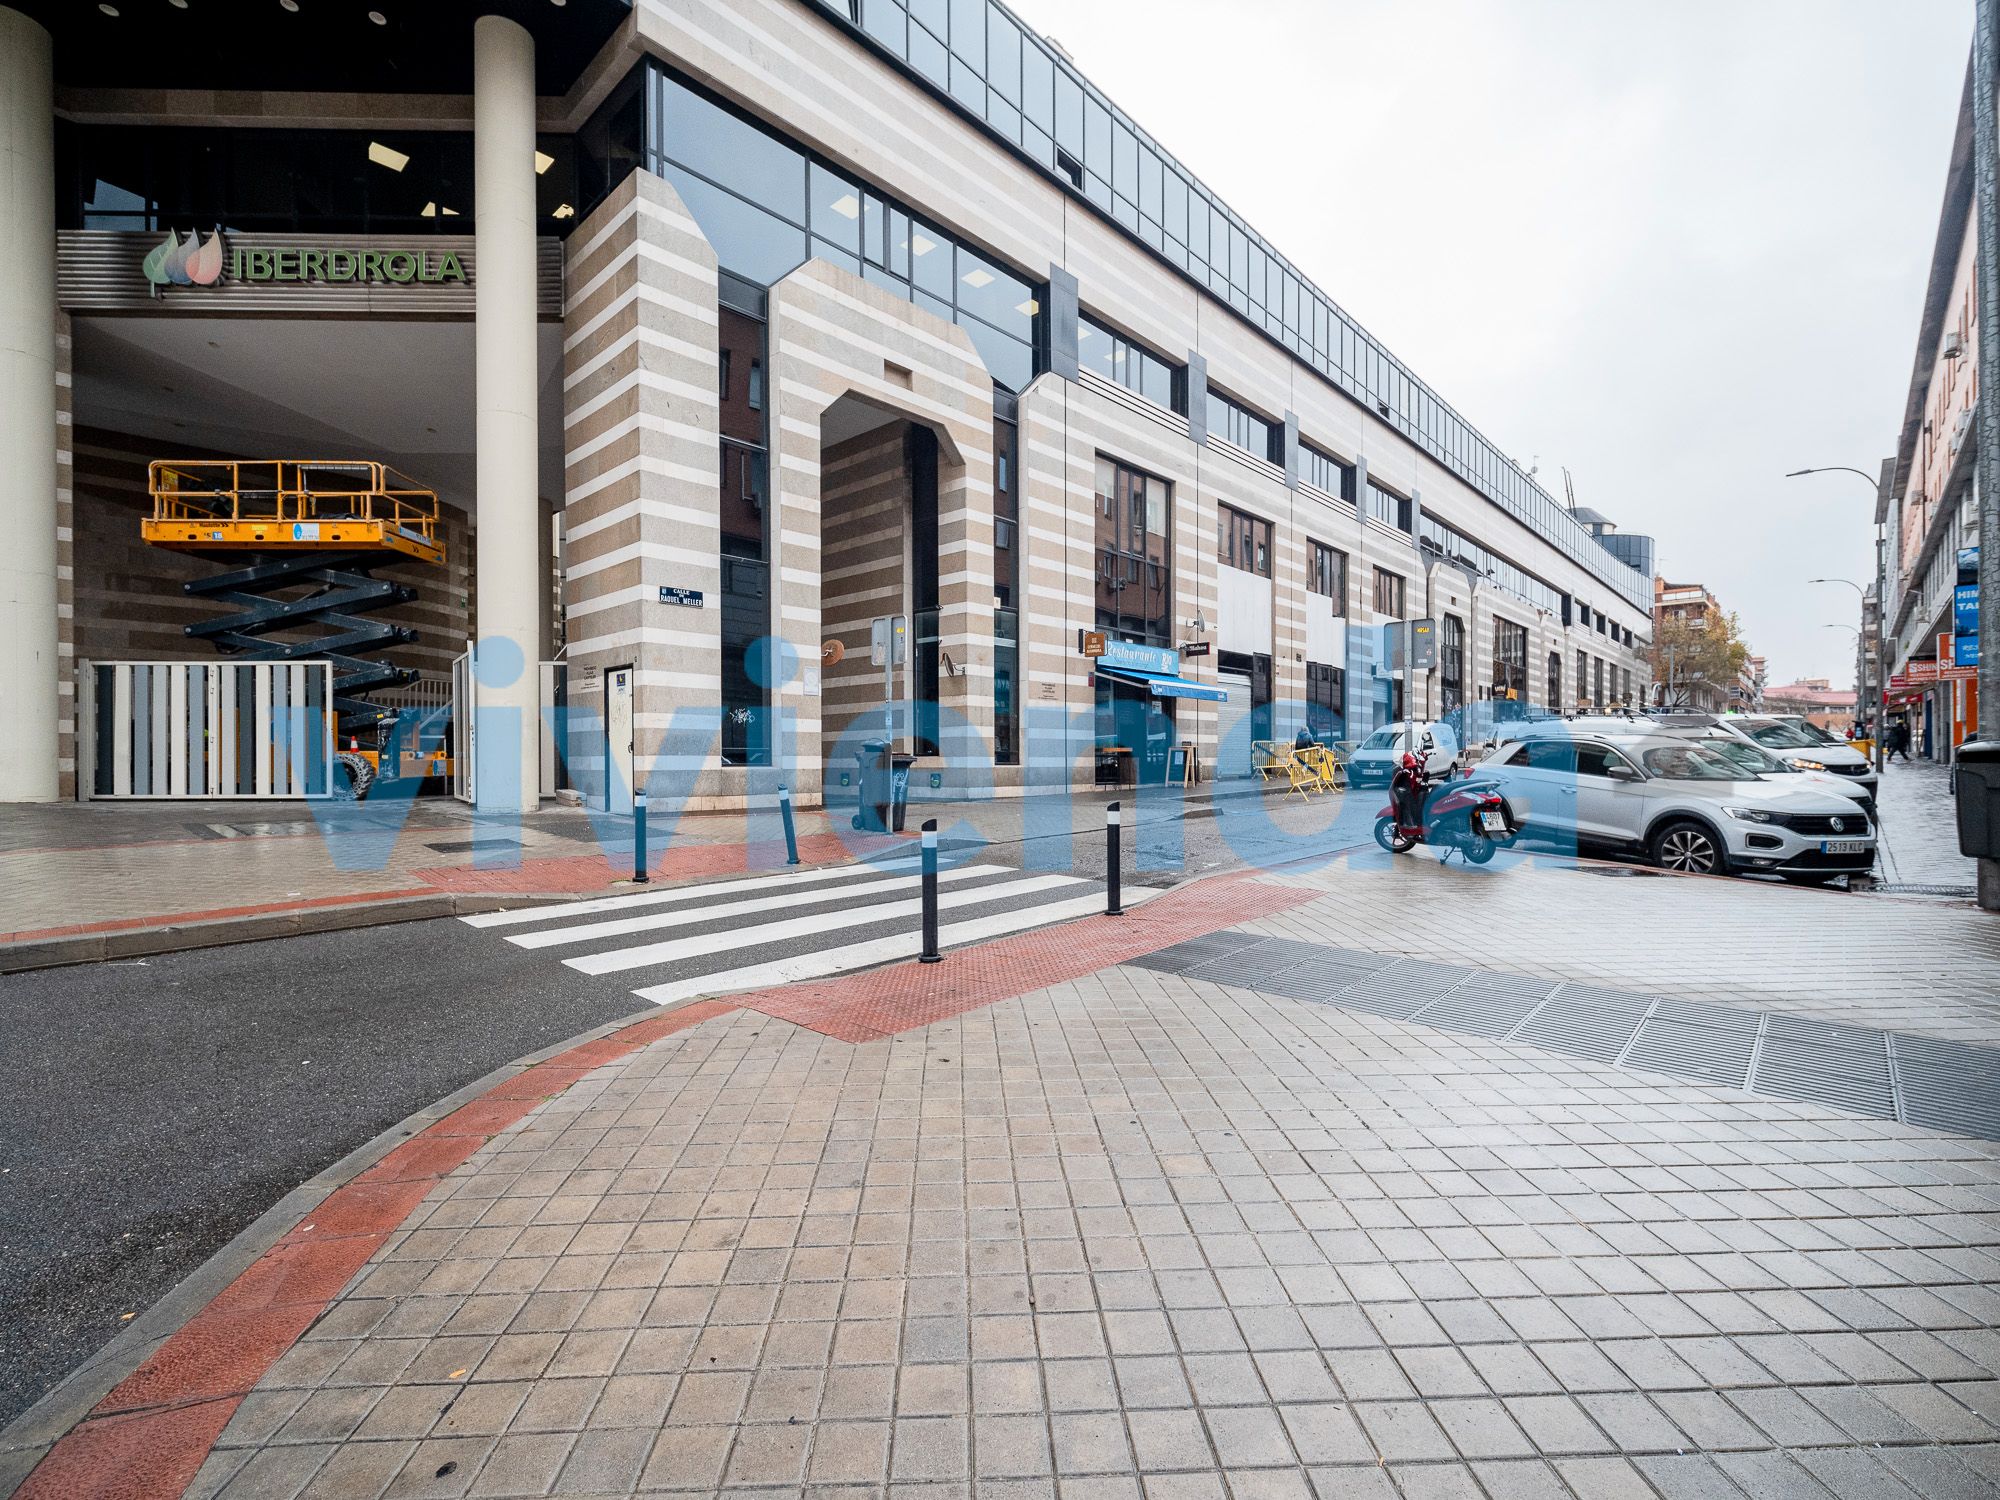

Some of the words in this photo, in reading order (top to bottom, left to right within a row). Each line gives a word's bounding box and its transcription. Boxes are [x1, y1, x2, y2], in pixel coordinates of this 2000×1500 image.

[233, 247, 466, 282] IBERDROLA
[1957, 590, 1979, 599] HIM
[660, 595, 681, 604] RAQUEL
[682, 597, 703, 607] MELLER
[1104, 640, 1157, 662] Restaurante
[1827, 842, 1848, 852] 2513
